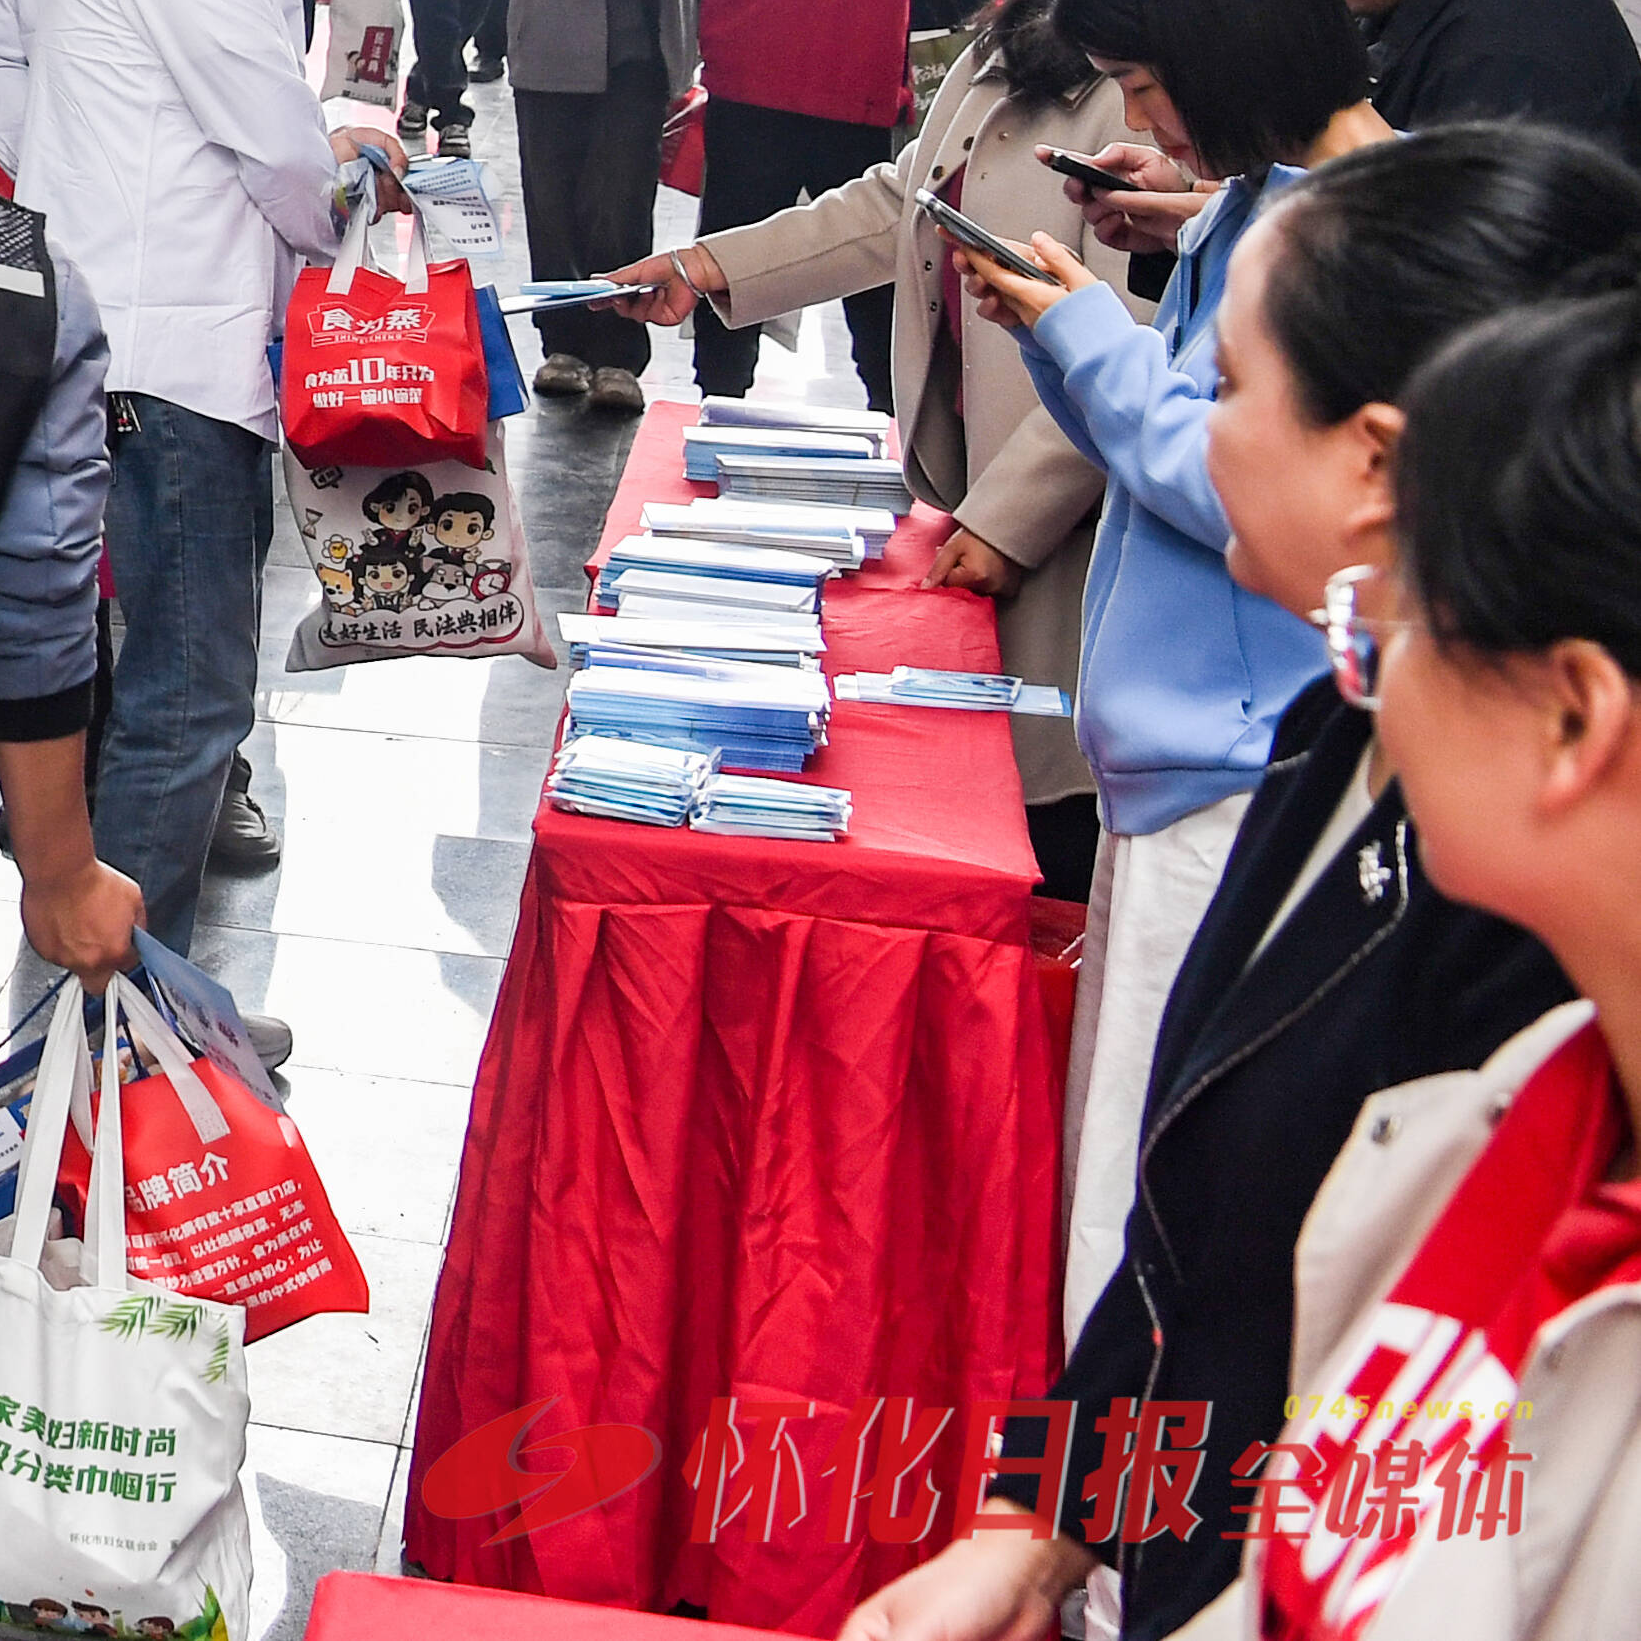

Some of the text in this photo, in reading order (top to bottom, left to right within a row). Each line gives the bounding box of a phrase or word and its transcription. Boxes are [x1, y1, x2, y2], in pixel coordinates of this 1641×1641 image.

[321, 307, 423, 335] 食为蒸
[414, 600, 518, 639] 民法典相伴
[125, 1151, 229, 1213] 品牌简介
